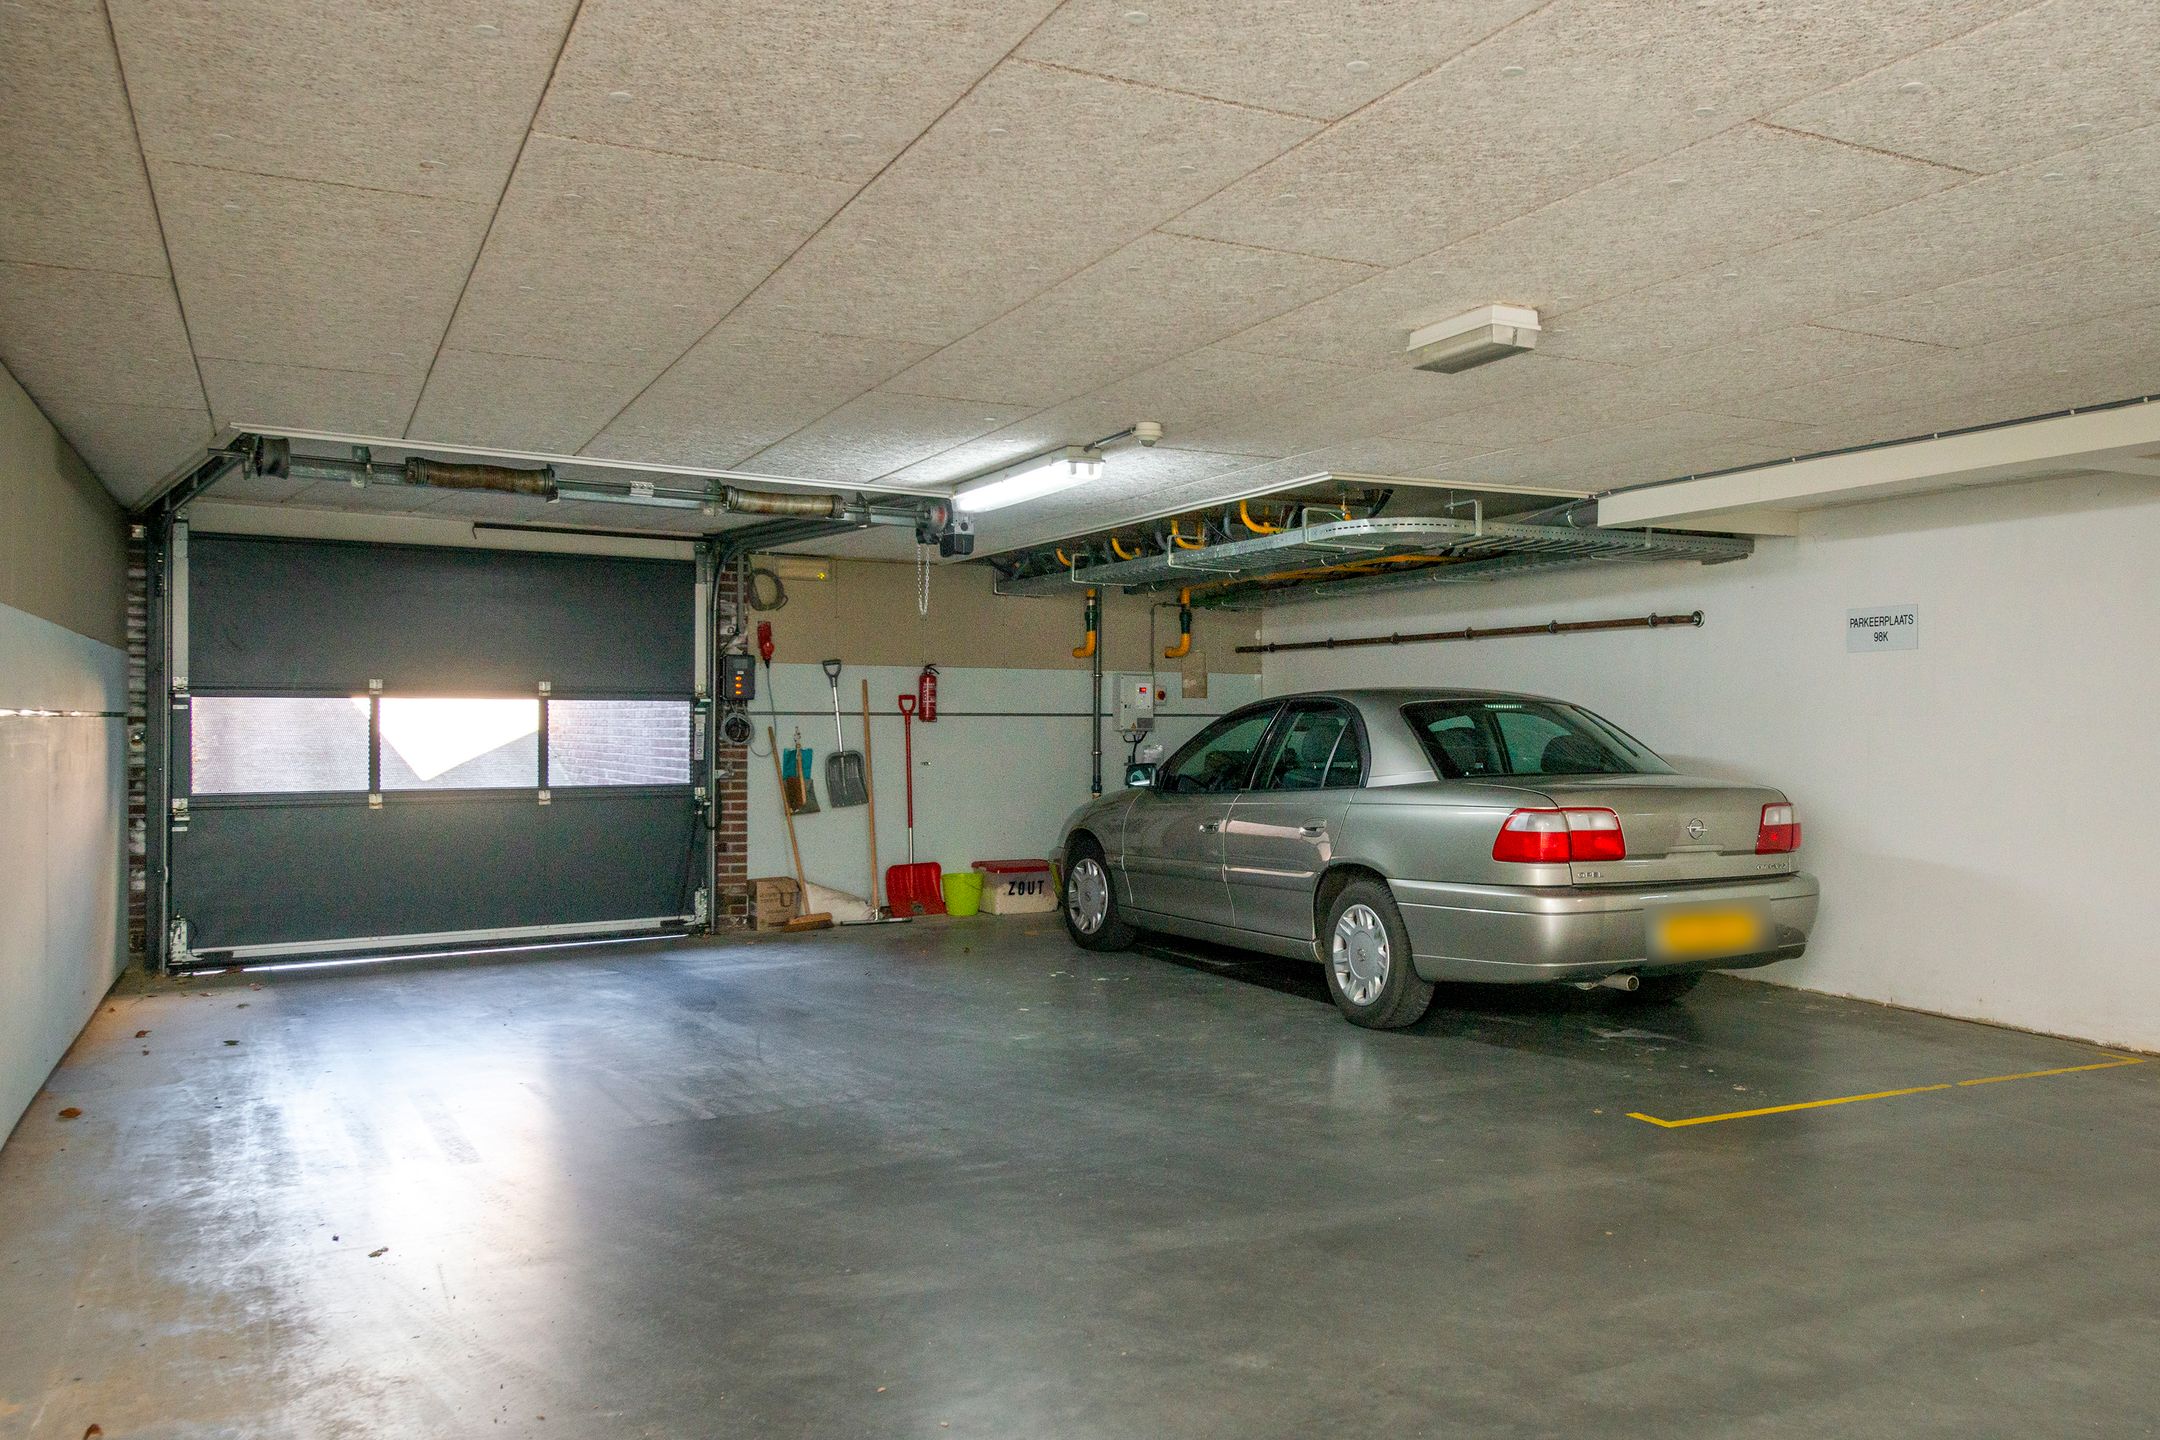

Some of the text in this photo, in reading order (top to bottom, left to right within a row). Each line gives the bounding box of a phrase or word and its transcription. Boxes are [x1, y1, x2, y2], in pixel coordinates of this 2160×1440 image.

[1849, 614, 1914, 628] PARKEERPLAATS
[1873, 631, 1889, 642] 98K
[1008, 880, 1045, 896] ZOUT
